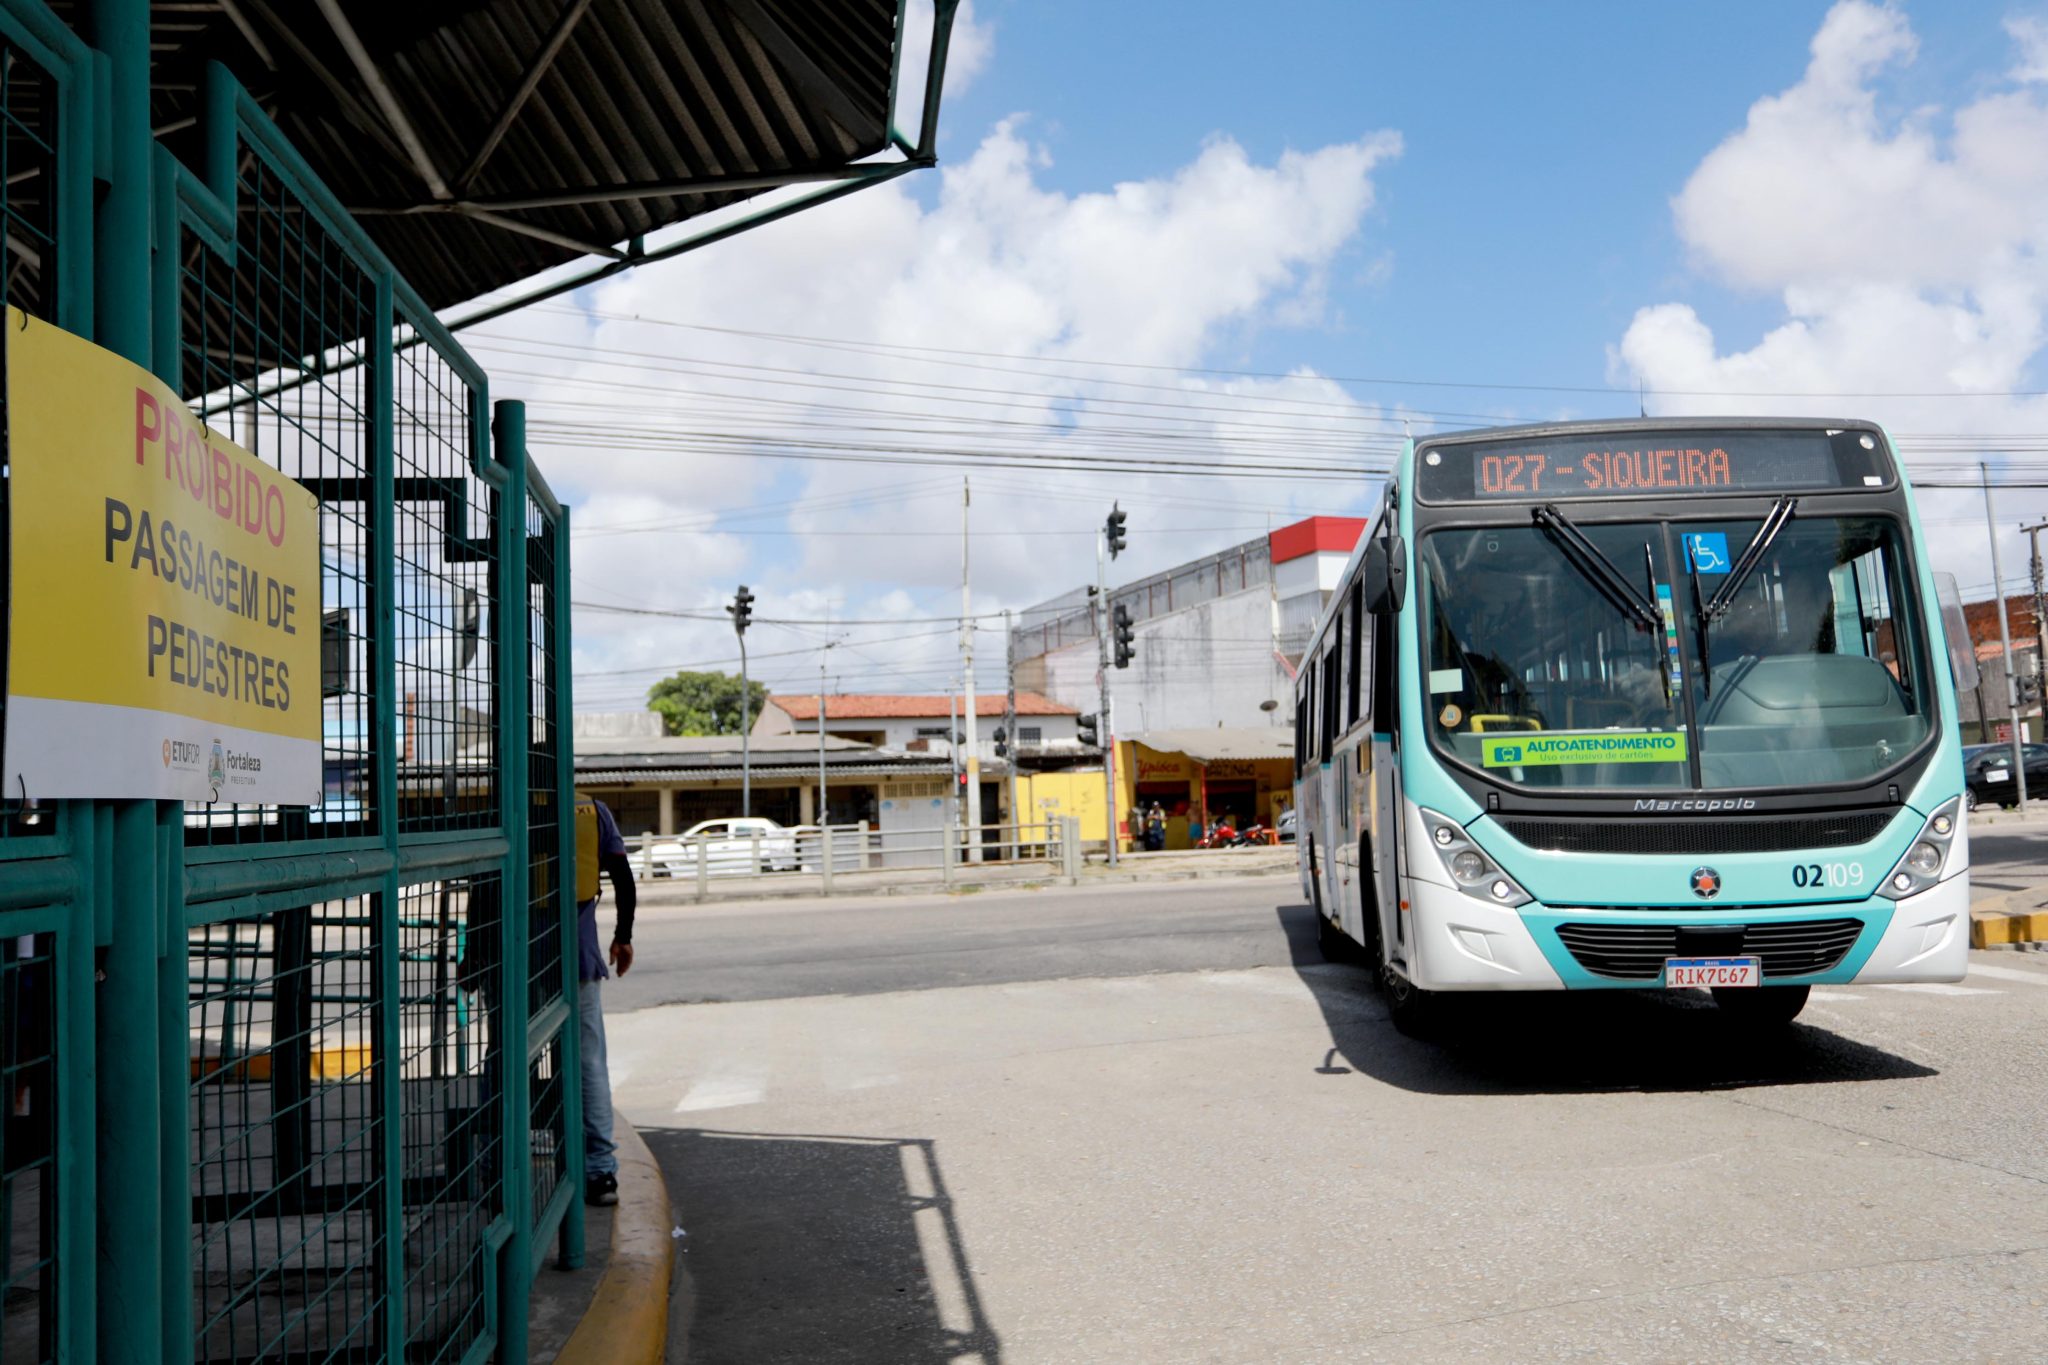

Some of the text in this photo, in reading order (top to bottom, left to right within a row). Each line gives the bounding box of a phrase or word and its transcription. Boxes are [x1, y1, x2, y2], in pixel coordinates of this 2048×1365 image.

[135, 386, 286, 548] PROIBIDO
[1482, 453, 1545, 492] 027
[1582, 448, 1731, 490] SIQUEIRA
[104, 496, 296, 635] PASSAGEM DE
[147, 614, 291, 712] PEDESTRES
[1526, 737, 1676, 753] AUTOATENDIMENTO
[1539, 750, 1654, 762] Uso exclusivo de cartões
[227, 750, 261, 772] Fortaleza
[1634, 798, 1756, 812] Marcopolo
[1792, 862, 1864, 888] 02109
[1675, 967, 1749, 984] RIK7C67
